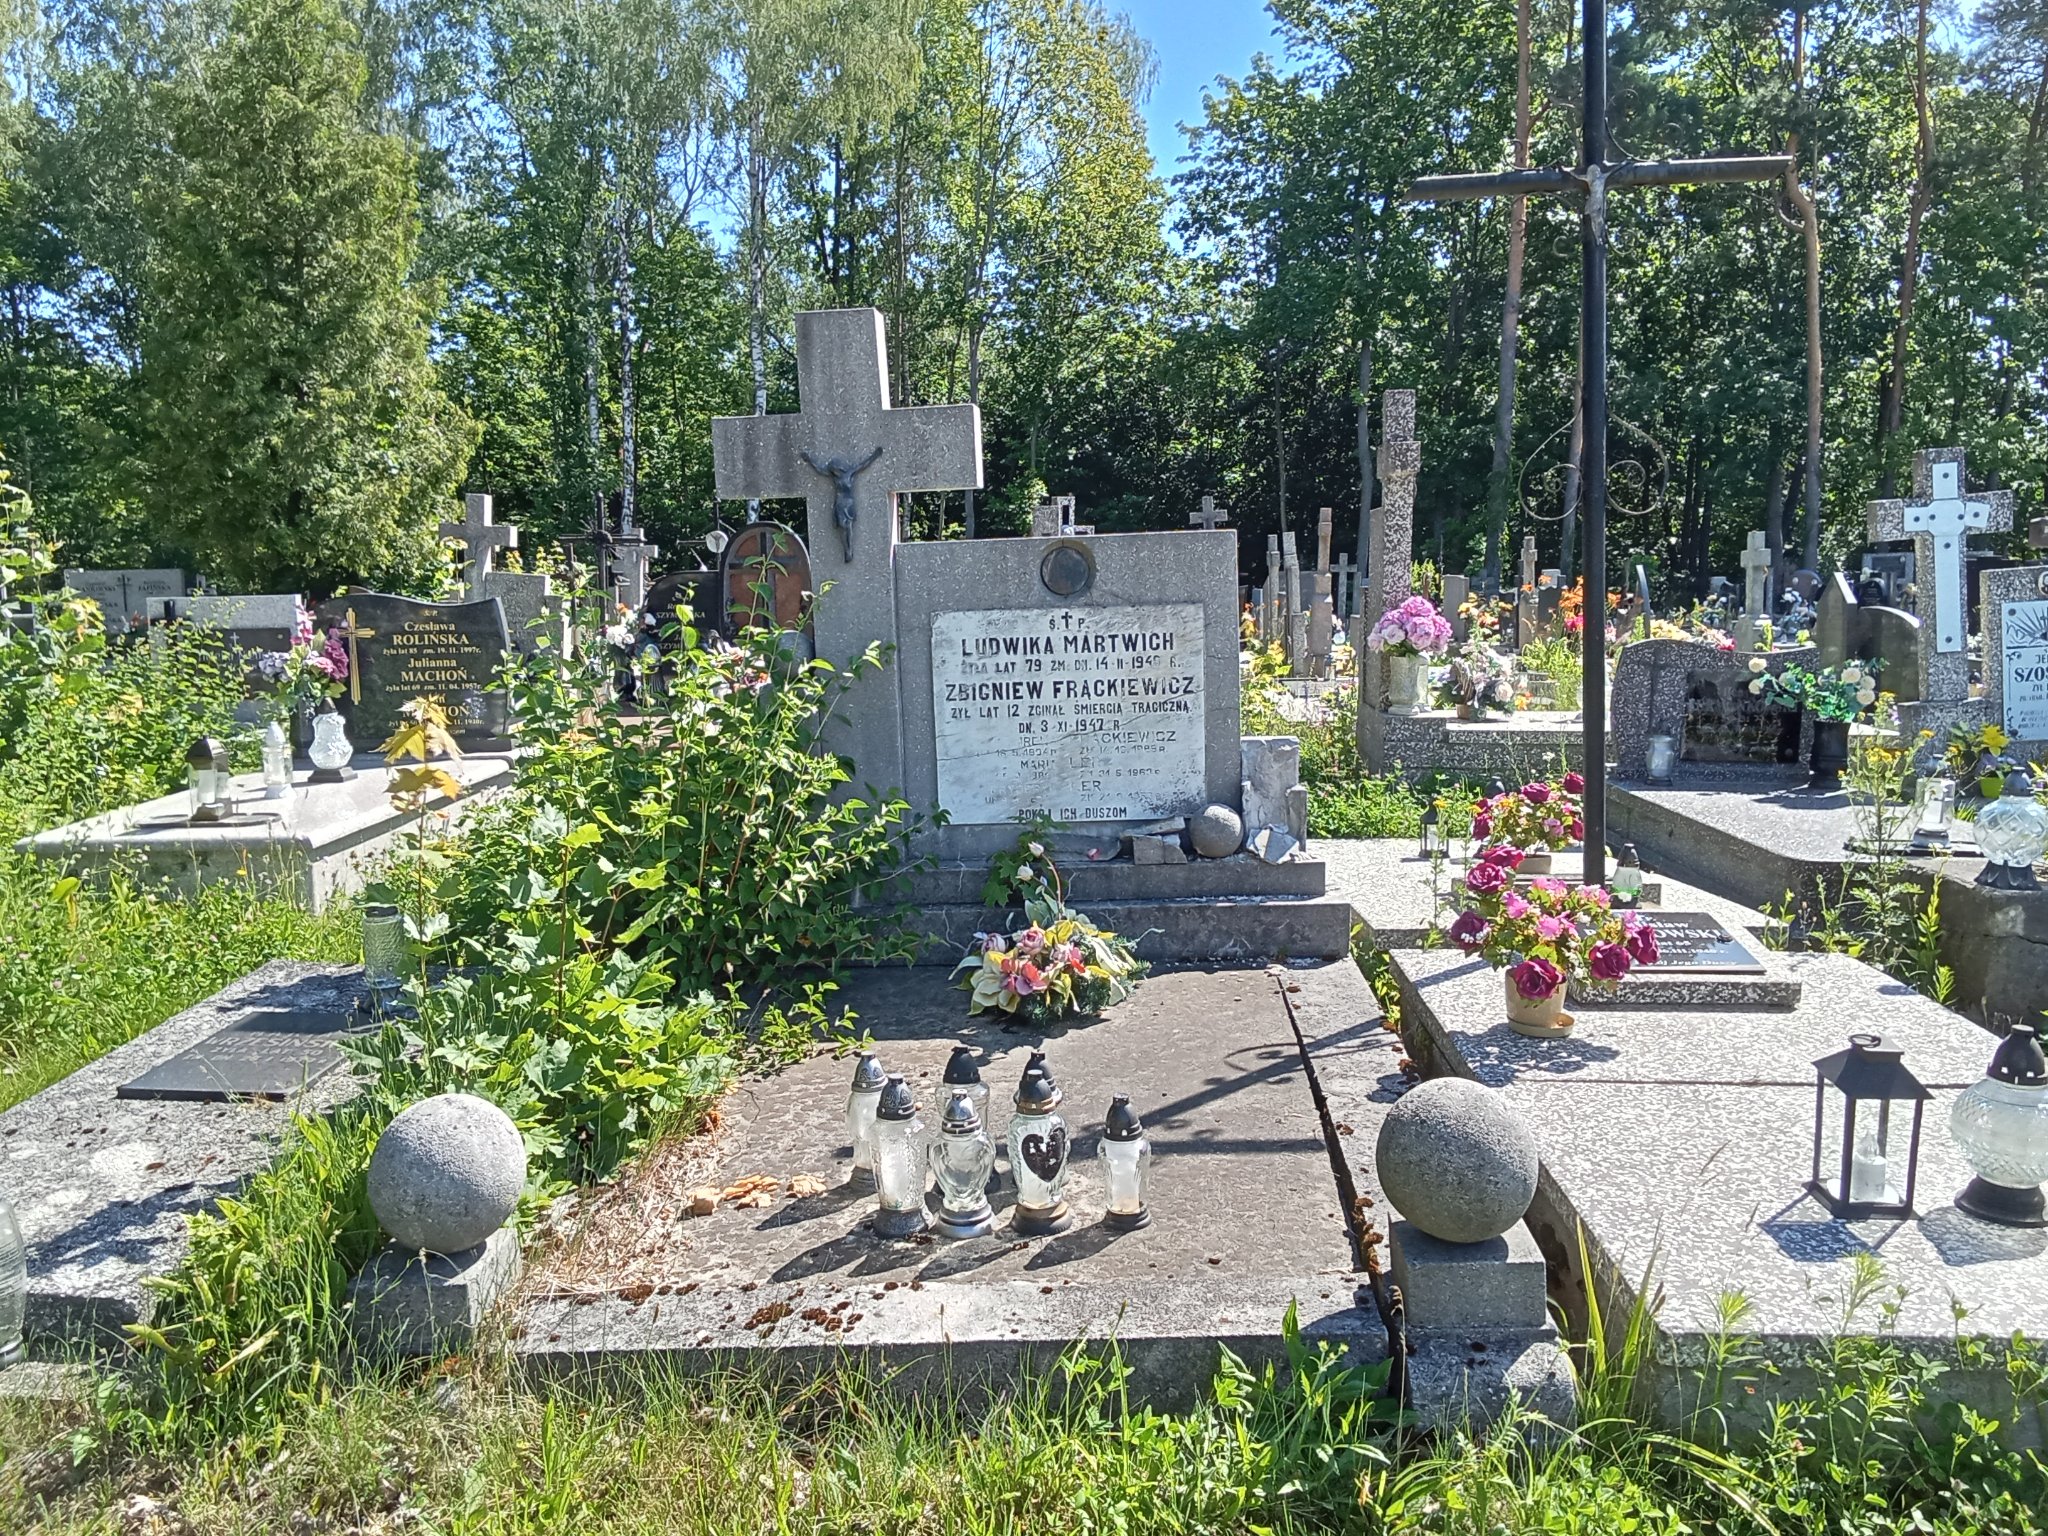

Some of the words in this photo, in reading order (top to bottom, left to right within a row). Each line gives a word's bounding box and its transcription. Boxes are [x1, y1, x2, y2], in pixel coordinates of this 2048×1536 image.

[404, 621, 456, 632] Czesława
[392, 631, 470, 646] ROLIŃSKA
[961, 635, 1055, 657] LUDWIKA
[1063, 631, 1175, 654] MARTWICH
[398, 647, 408, 655] lat
[407, 657, 458, 669] Julianna
[995, 661, 1017, 674] LAT
[1025, 658, 1043, 672] 79
[400, 667, 469, 682] MACHOŃ
[401, 684, 411, 692] lat
[945, 680, 1044, 702] ZBIGNIEW
[1052, 675, 1195, 700] FRĄCKIEWICZ
[979, 706, 1000, 718] LAT
[1007, 703, 1020, 718] 12
[1060, 808, 1078, 821] ICH
[1085, 806, 1128, 819] DUSZOM
